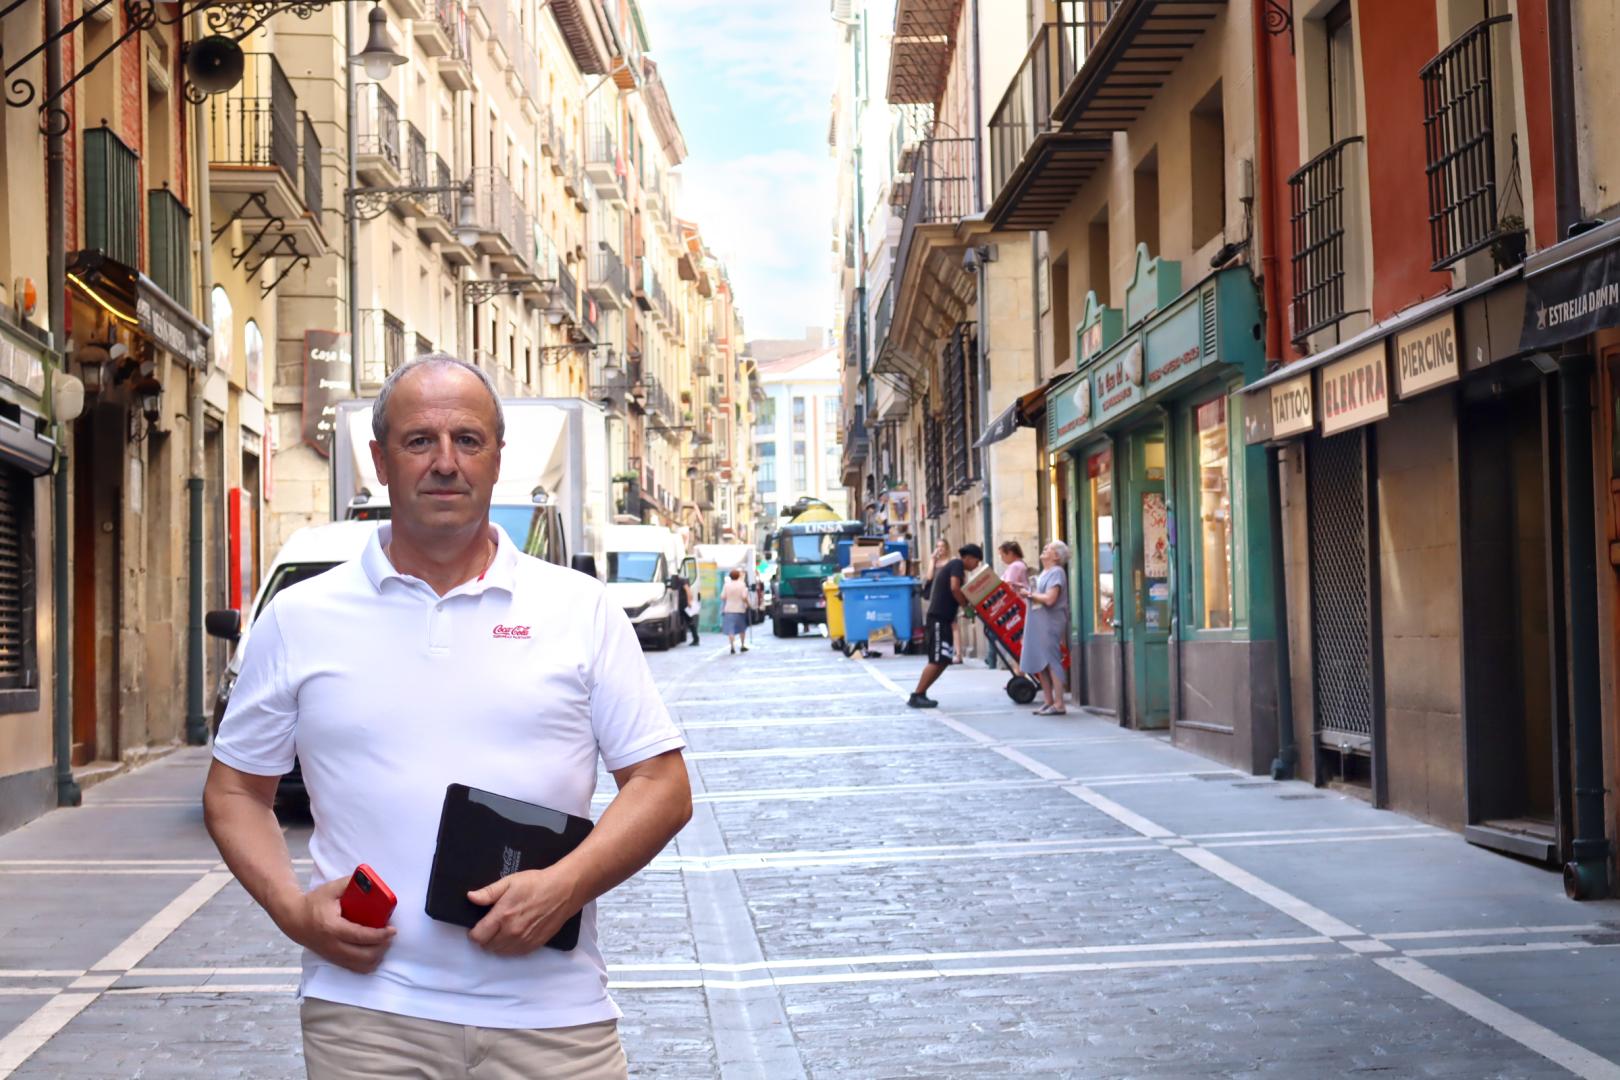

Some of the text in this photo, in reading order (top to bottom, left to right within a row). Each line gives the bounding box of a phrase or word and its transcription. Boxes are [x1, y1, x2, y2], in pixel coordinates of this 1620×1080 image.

[1549, 282, 1619, 326] ESTRELLA DAMM
[1400, 327, 1455, 381] PIERCING
[1273, 387, 1310, 424] TATTOO
[1325, 360, 1385, 418] ELEKTRA
